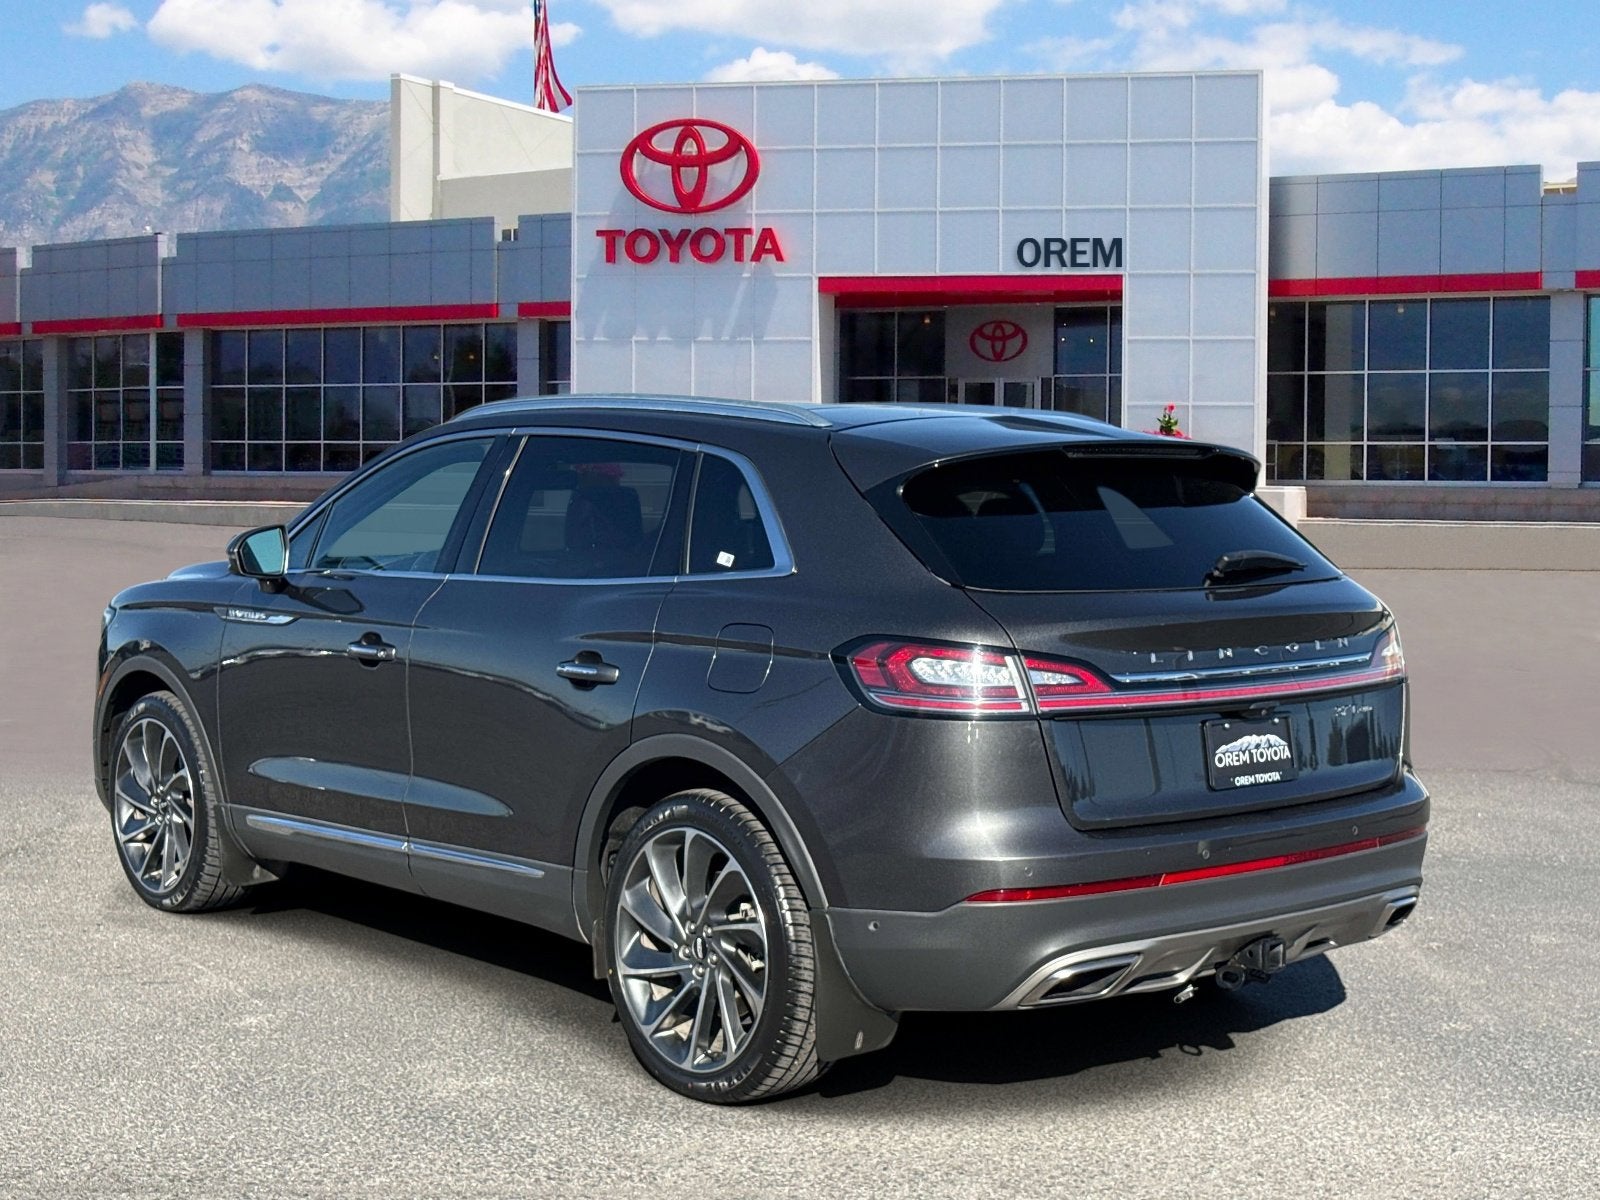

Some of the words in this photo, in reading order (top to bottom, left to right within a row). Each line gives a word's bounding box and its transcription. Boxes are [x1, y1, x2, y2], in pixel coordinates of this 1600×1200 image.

[596, 227, 784, 264] TOYOTA
[1017, 237, 1123, 268] OREM
[1151, 637, 1349, 664] LINCOLN
[1214, 750, 1250, 768] OREM
[1251, 745, 1291, 763] TOYOTA
[1234, 774, 1255, 787] OREM
[1255, 772, 1281, 784] TOYOTA
